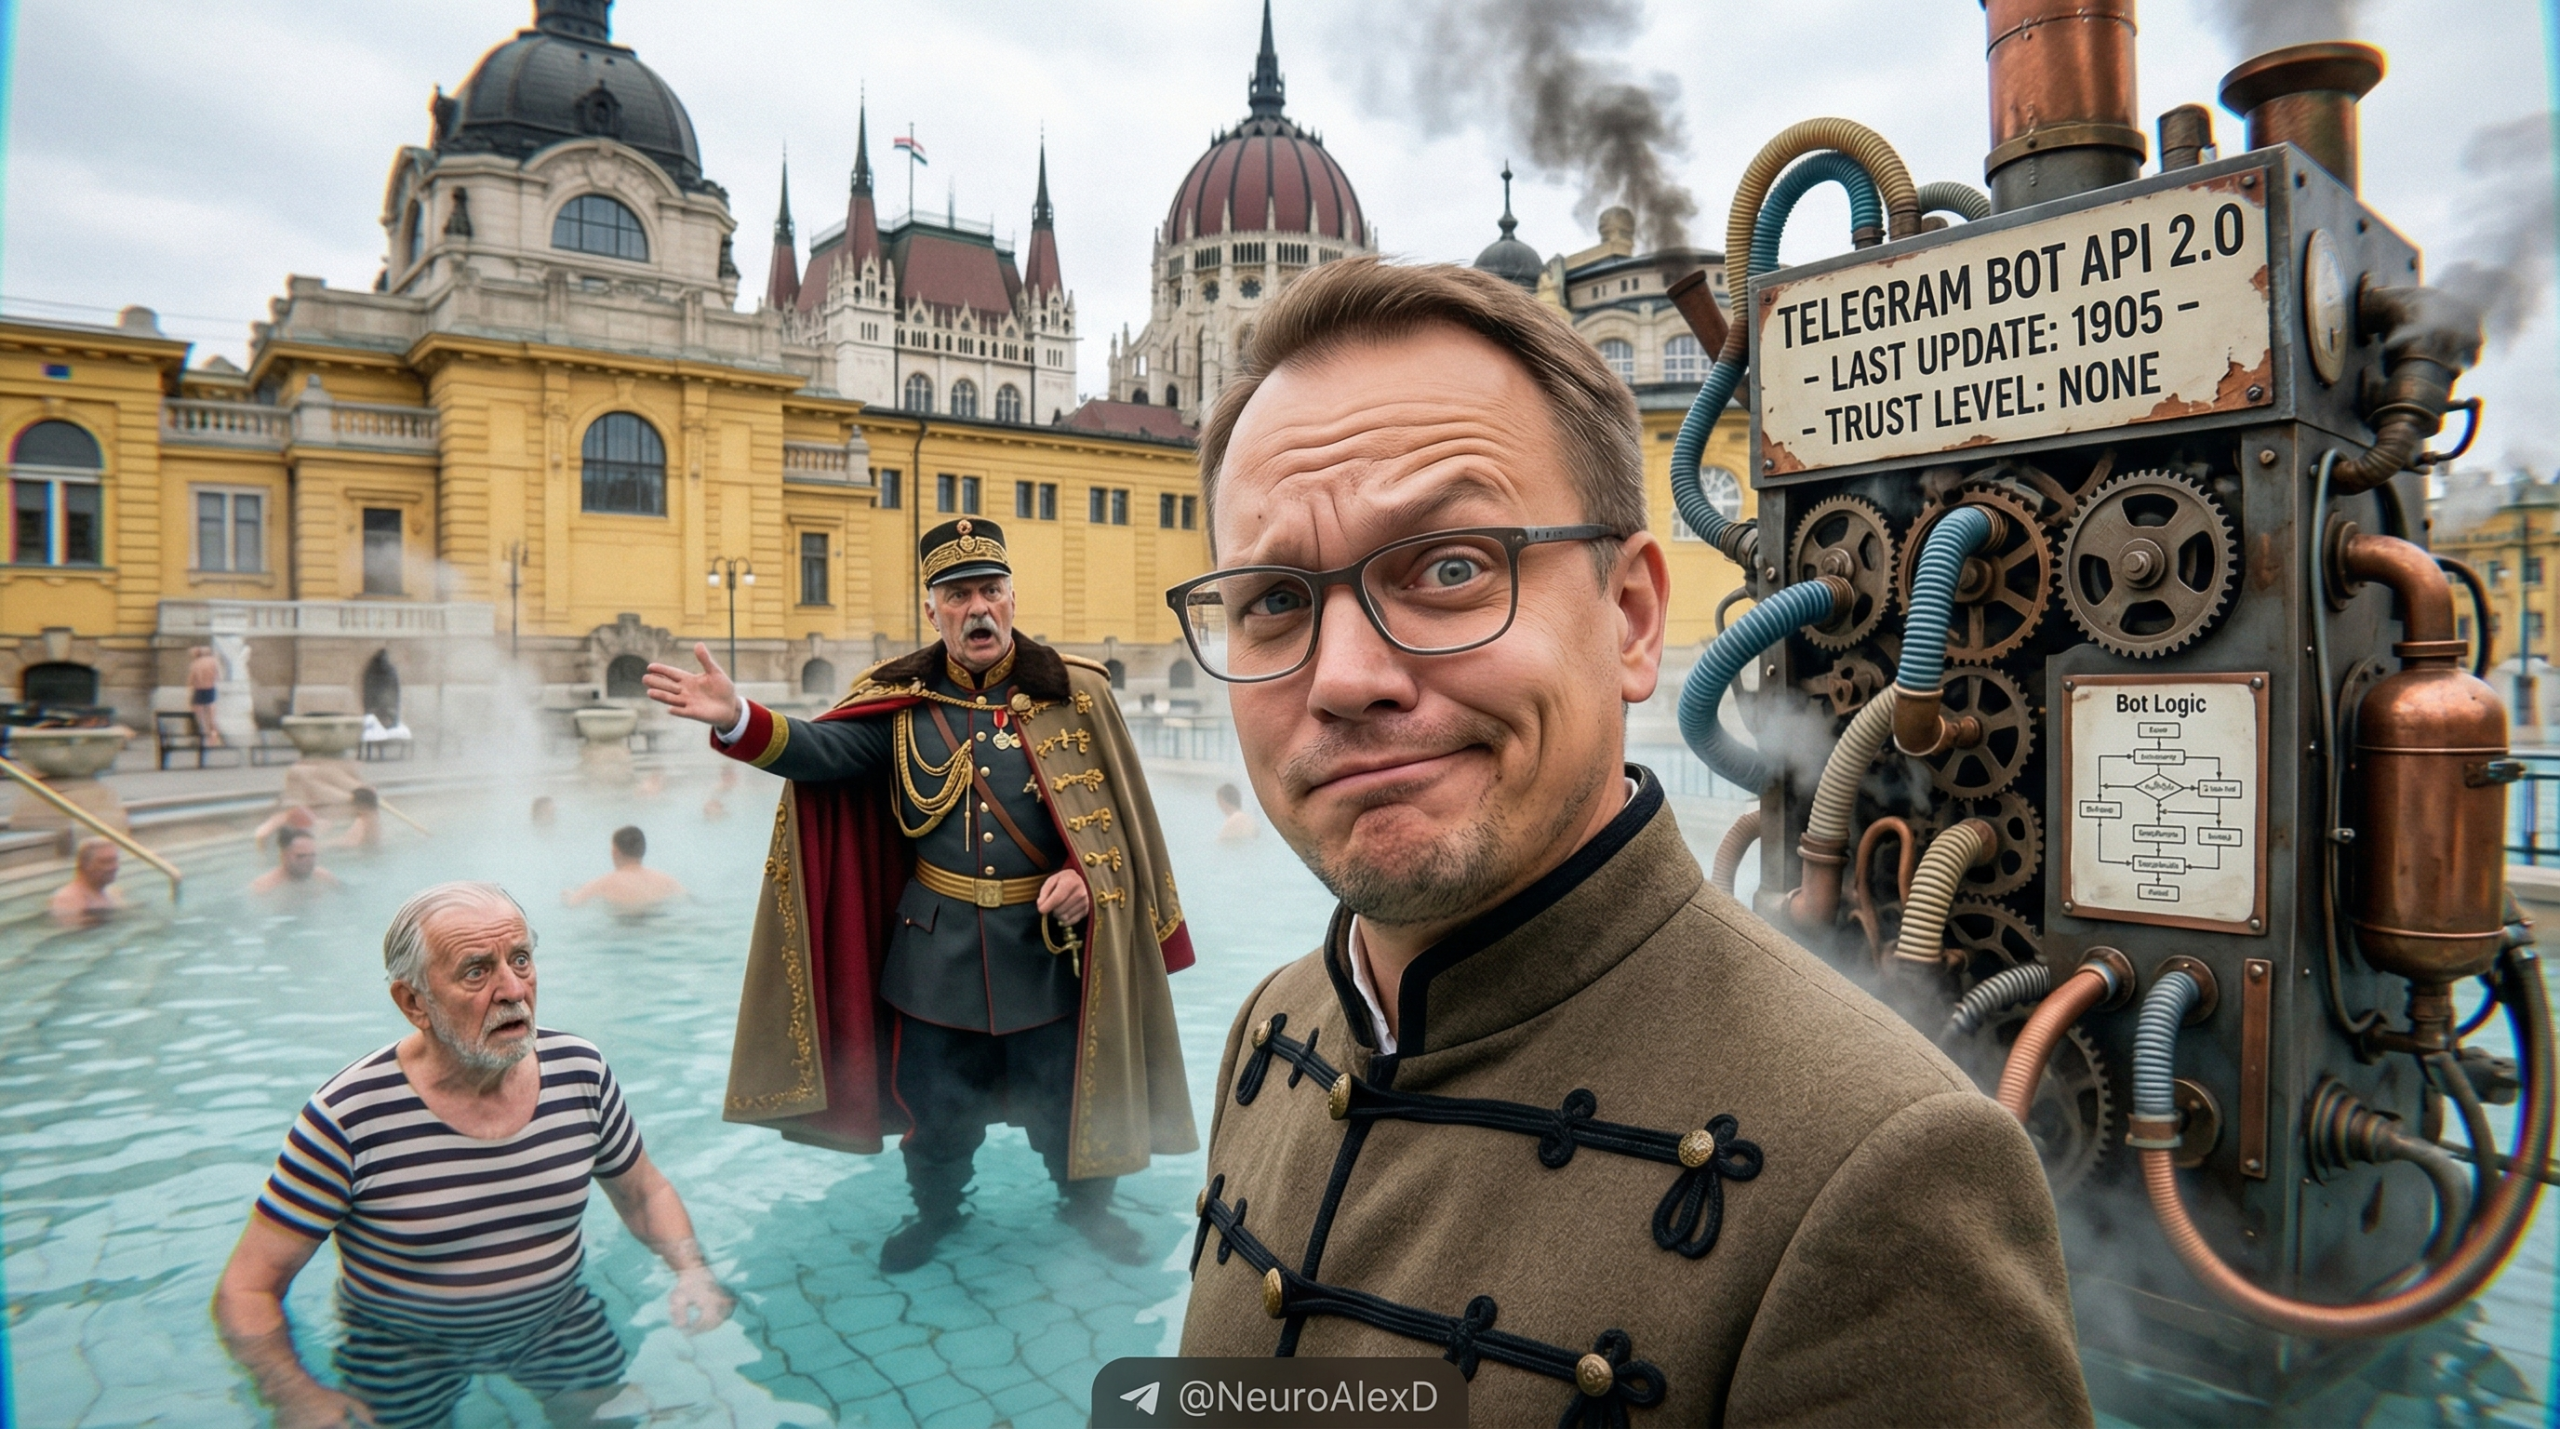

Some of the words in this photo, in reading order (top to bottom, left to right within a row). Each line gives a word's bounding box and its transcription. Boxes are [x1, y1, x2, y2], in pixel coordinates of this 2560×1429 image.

[1777, 265, 1972, 348] TELEGRAM
[1986, 243, 2066, 304] BOT
[2080, 223, 2152, 285] API
[2169, 203, 2243, 267] 2.0
[1832, 342, 1906, 391] LAST
[1917, 313, 2059, 374] UPDATE:
[2071, 290, 2163, 346] 1905
[1824, 394, 1923, 444] TRUST
[1934, 374, 2046, 427] LEVEL:
[2059, 352, 2161, 408] NONE
[2116, 694, 2148, 713] Bot
[2154, 693, 2207, 718] Logic
